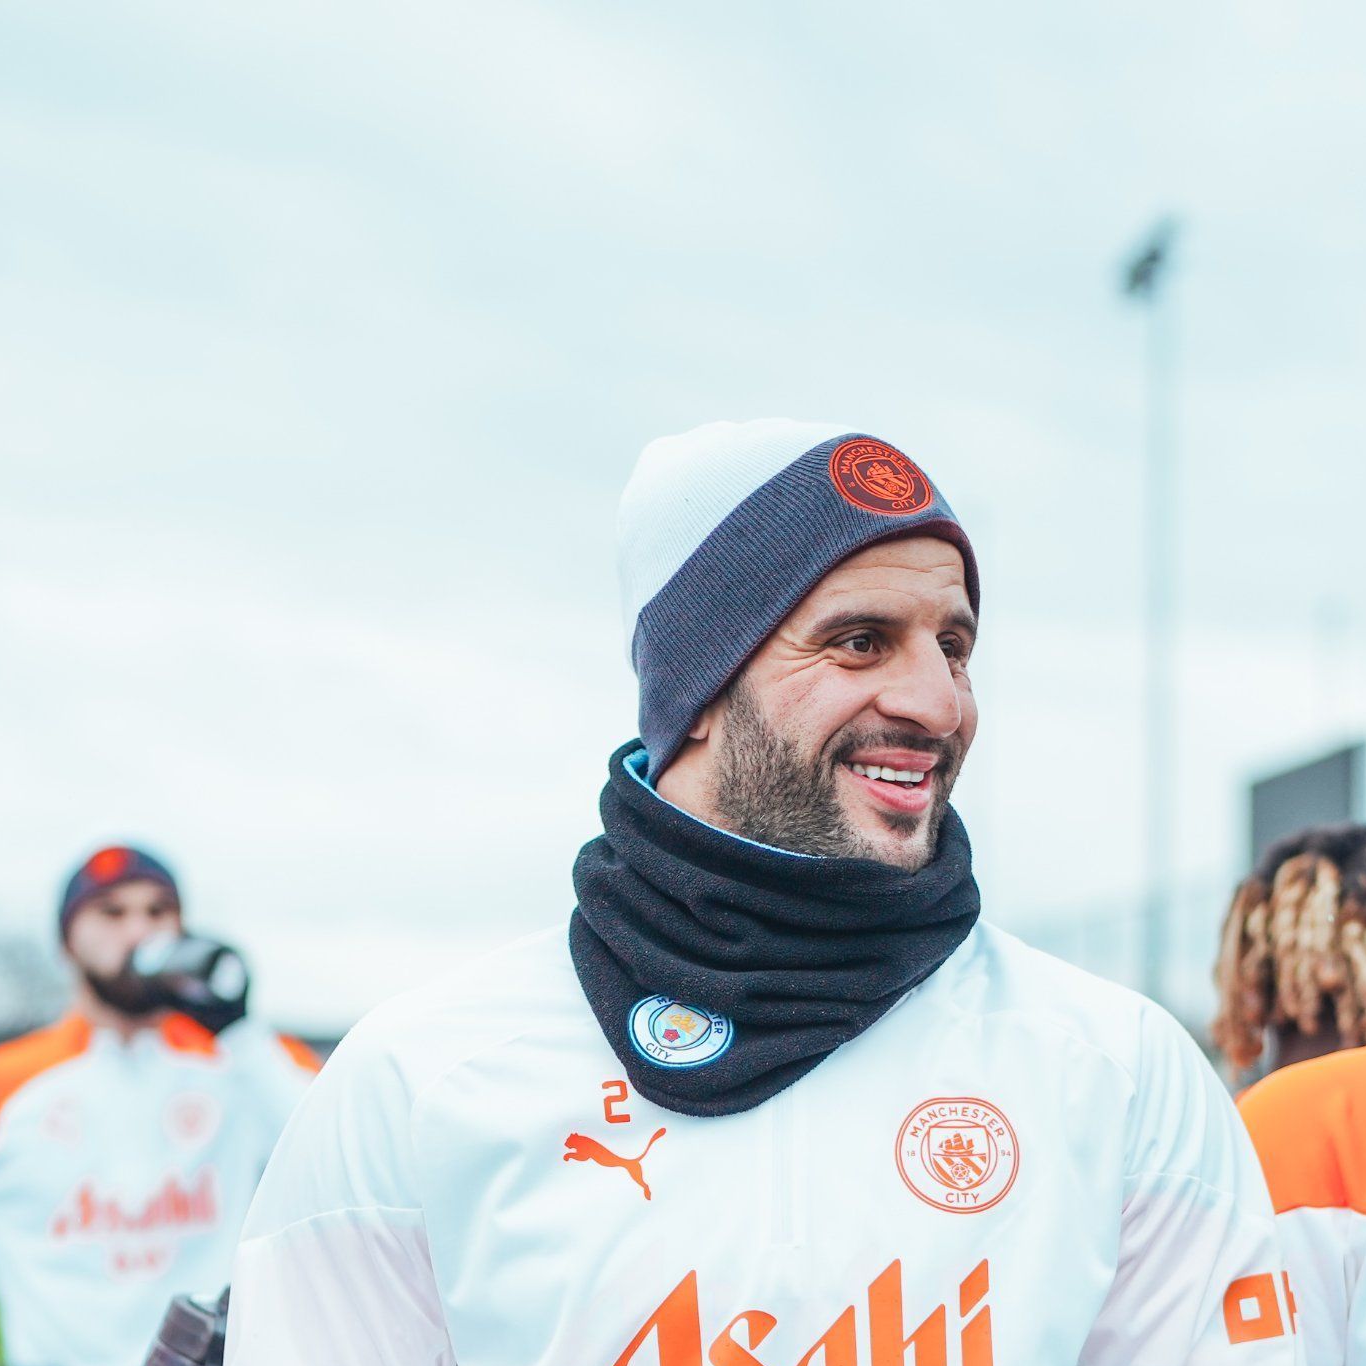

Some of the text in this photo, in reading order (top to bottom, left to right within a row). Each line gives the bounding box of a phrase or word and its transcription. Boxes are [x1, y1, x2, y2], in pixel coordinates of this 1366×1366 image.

[841, 446, 906, 474] MANCHESTER
[891, 498, 917, 510] CITY
[645, 1042, 672, 1060] CITY
[602, 1080, 631, 1124] 2
[909, 1106, 1006, 1139] MANCHESTER
[945, 1192, 980, 1204] CITY
